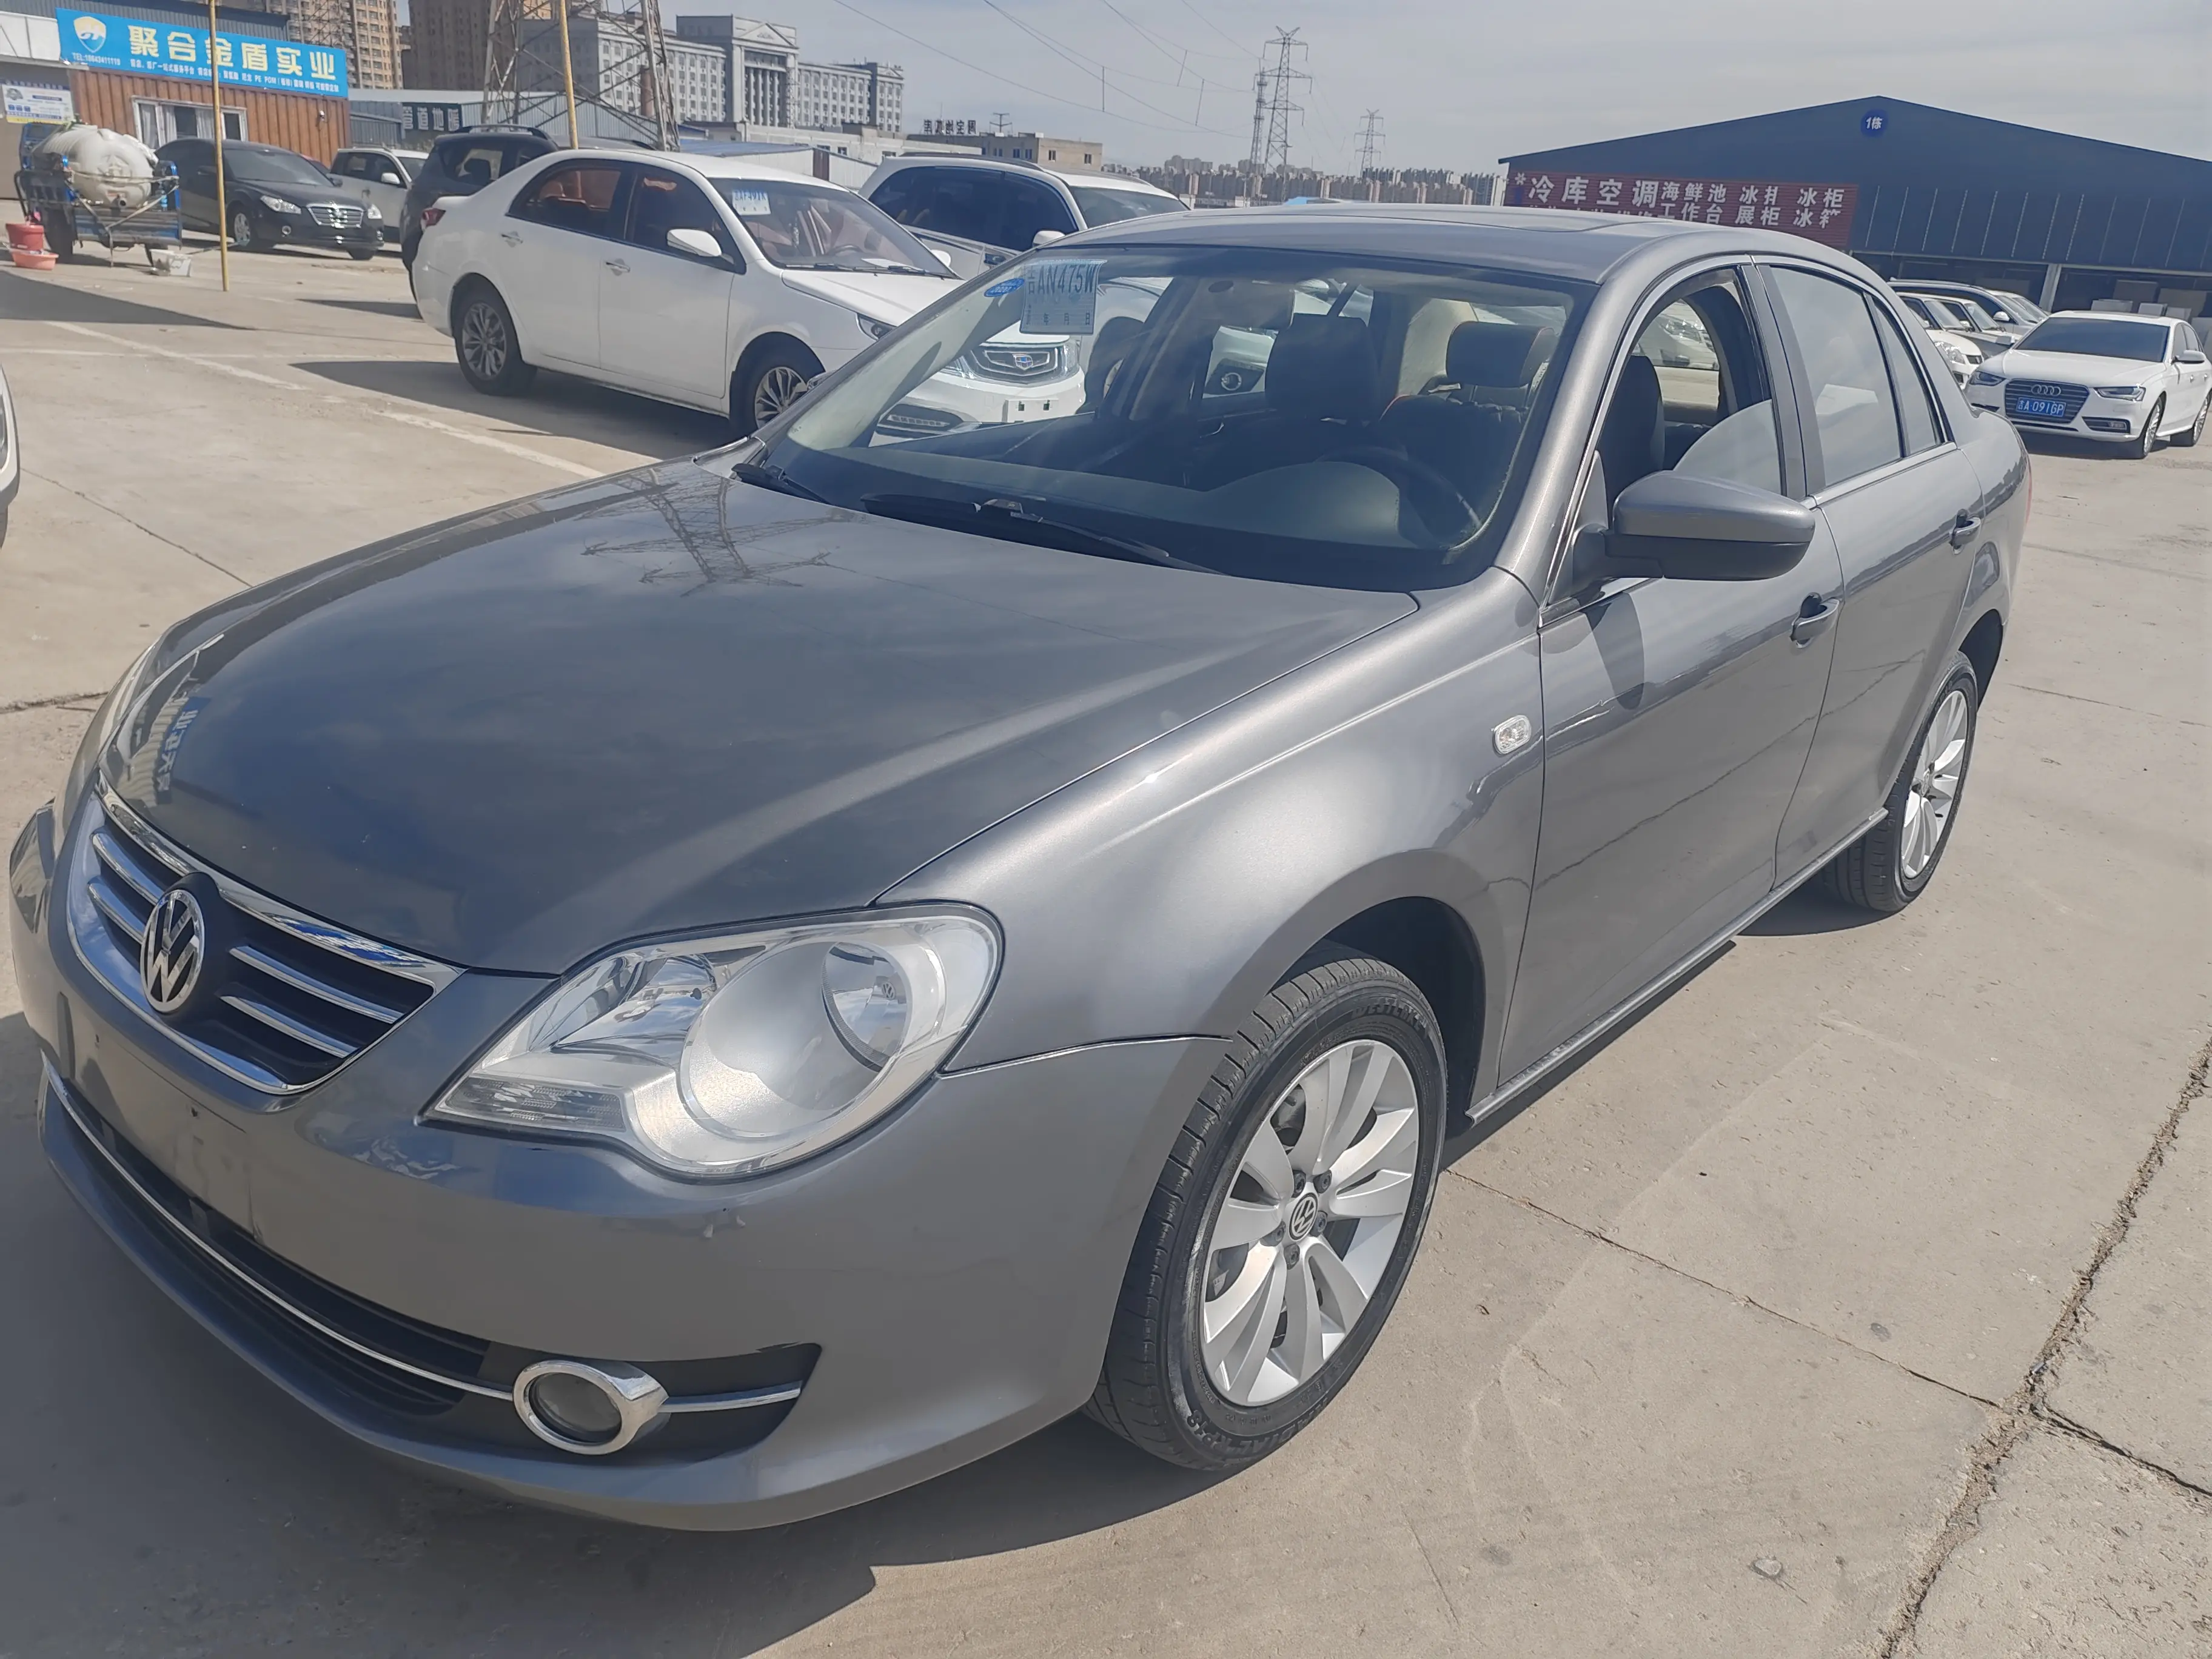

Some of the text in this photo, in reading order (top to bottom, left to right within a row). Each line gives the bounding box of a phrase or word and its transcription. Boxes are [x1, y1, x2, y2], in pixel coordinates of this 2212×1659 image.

[127, 25, 337, 81] 聚合金盾实业
[1529, 175, 1659, 209] 冷库空调
[1661, 181, 1727, 203] 海鲜池
[1797, 187, 1845, 209] 冰柜
[1657, 203, 1723, 224] 工作台
[1735, 205, 1781, 226] 展柜
